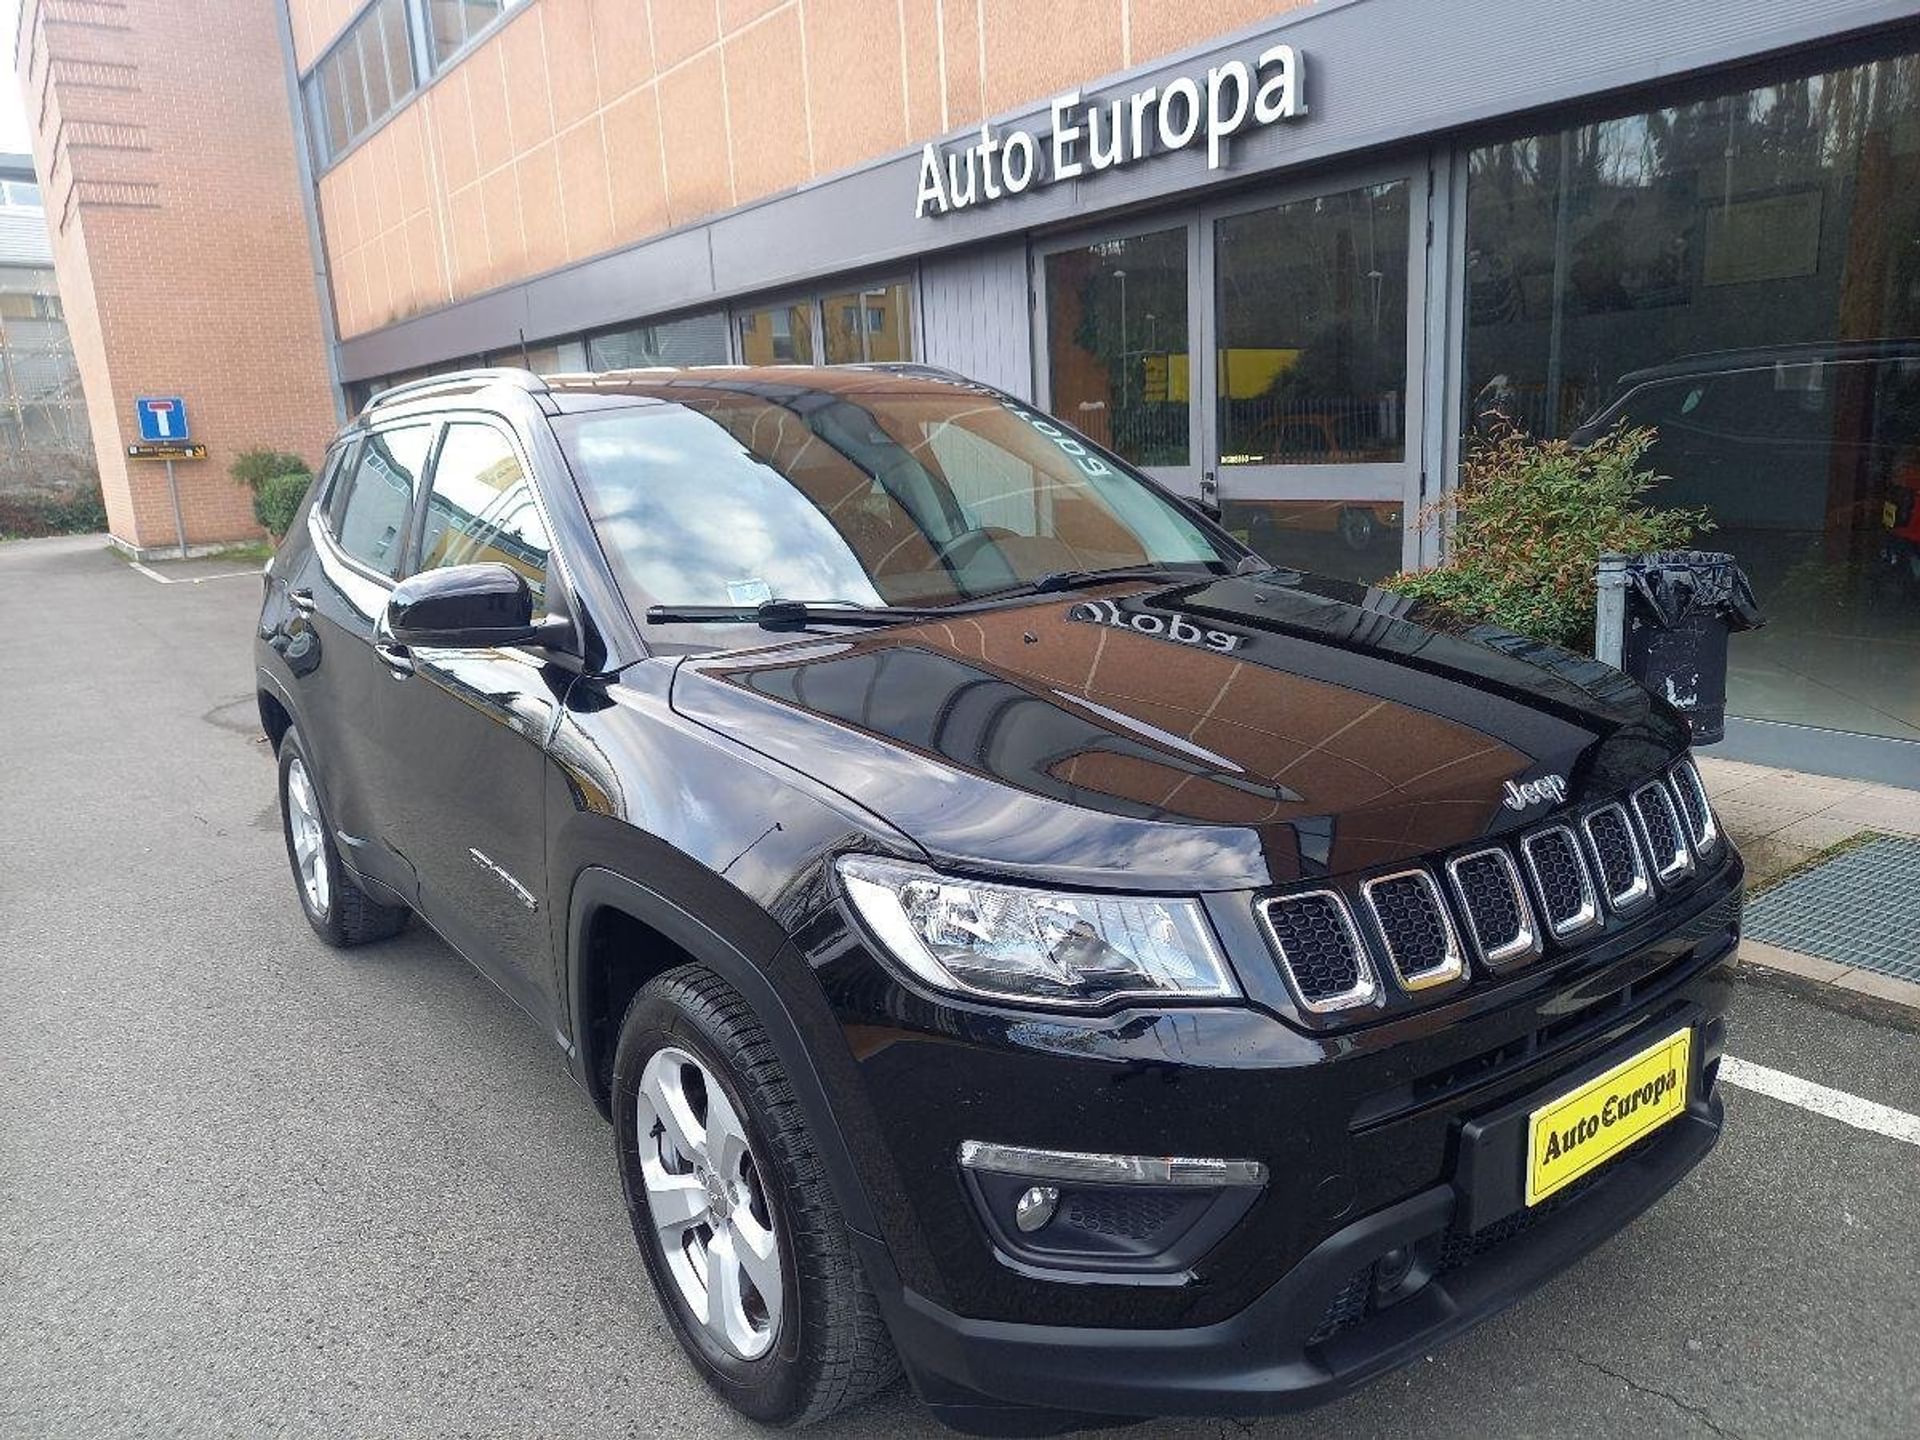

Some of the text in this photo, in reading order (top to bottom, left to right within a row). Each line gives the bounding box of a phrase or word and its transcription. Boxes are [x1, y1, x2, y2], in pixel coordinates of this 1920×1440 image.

[914, 43, 1304, 219] Auto Europa
[1502, 774, 1567, 811] Jeep
